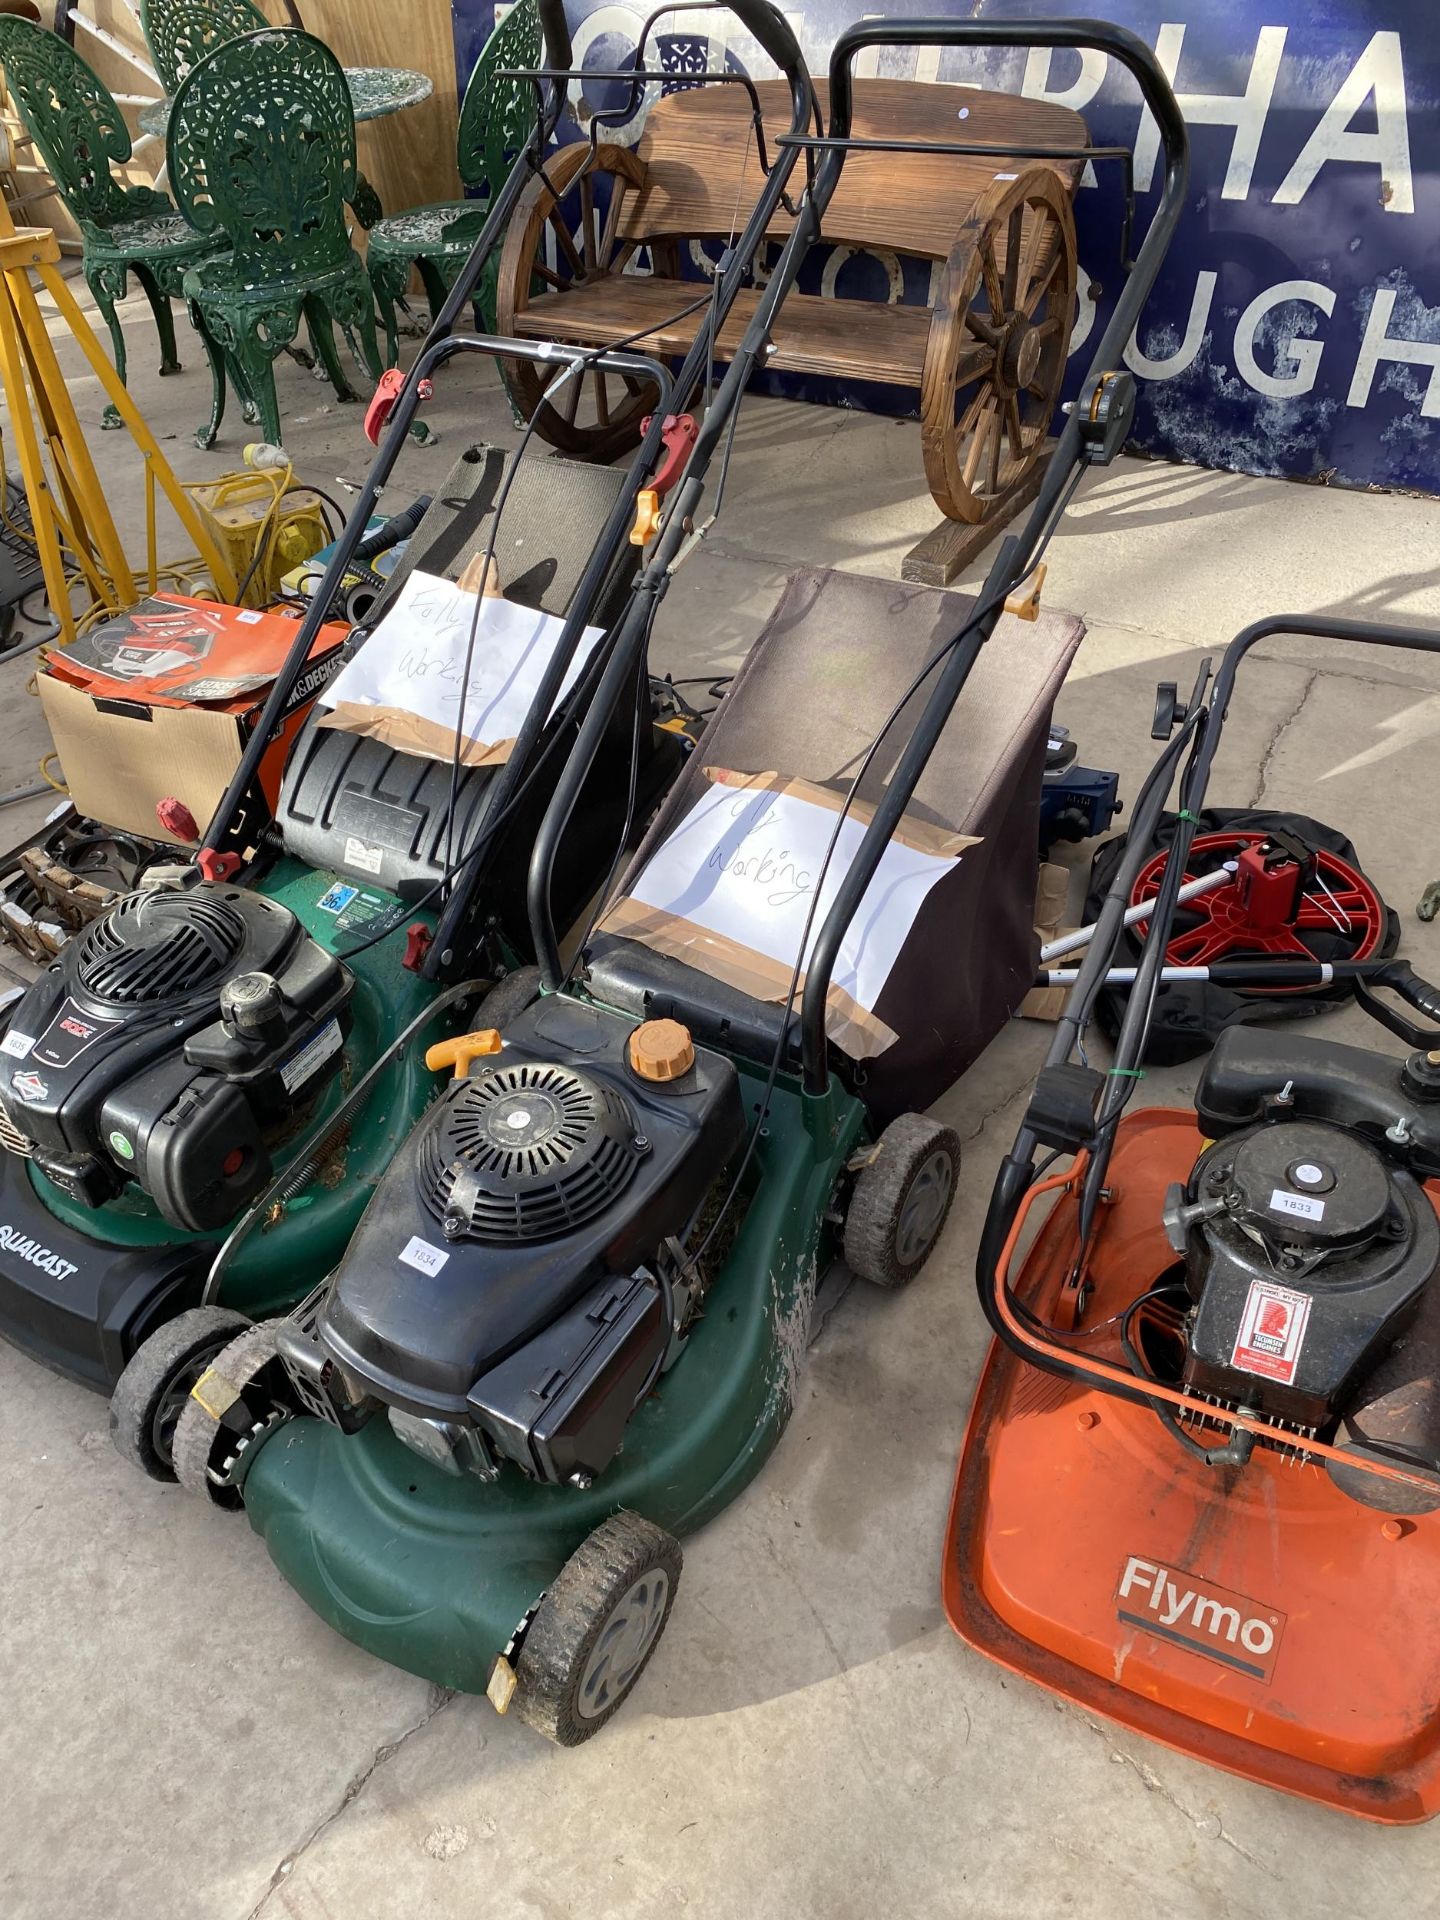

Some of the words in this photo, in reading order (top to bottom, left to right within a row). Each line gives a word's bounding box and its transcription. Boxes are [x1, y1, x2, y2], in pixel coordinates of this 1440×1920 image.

[708, 842, 815, 907] Working
[1283, 1200, 1312, 1213] 1833
[0, 1225, 79, 1280] QUALCAST
[412, 1248, 437, 1267] 1834
[1118, 1556, 1274, 1655] Flymo
